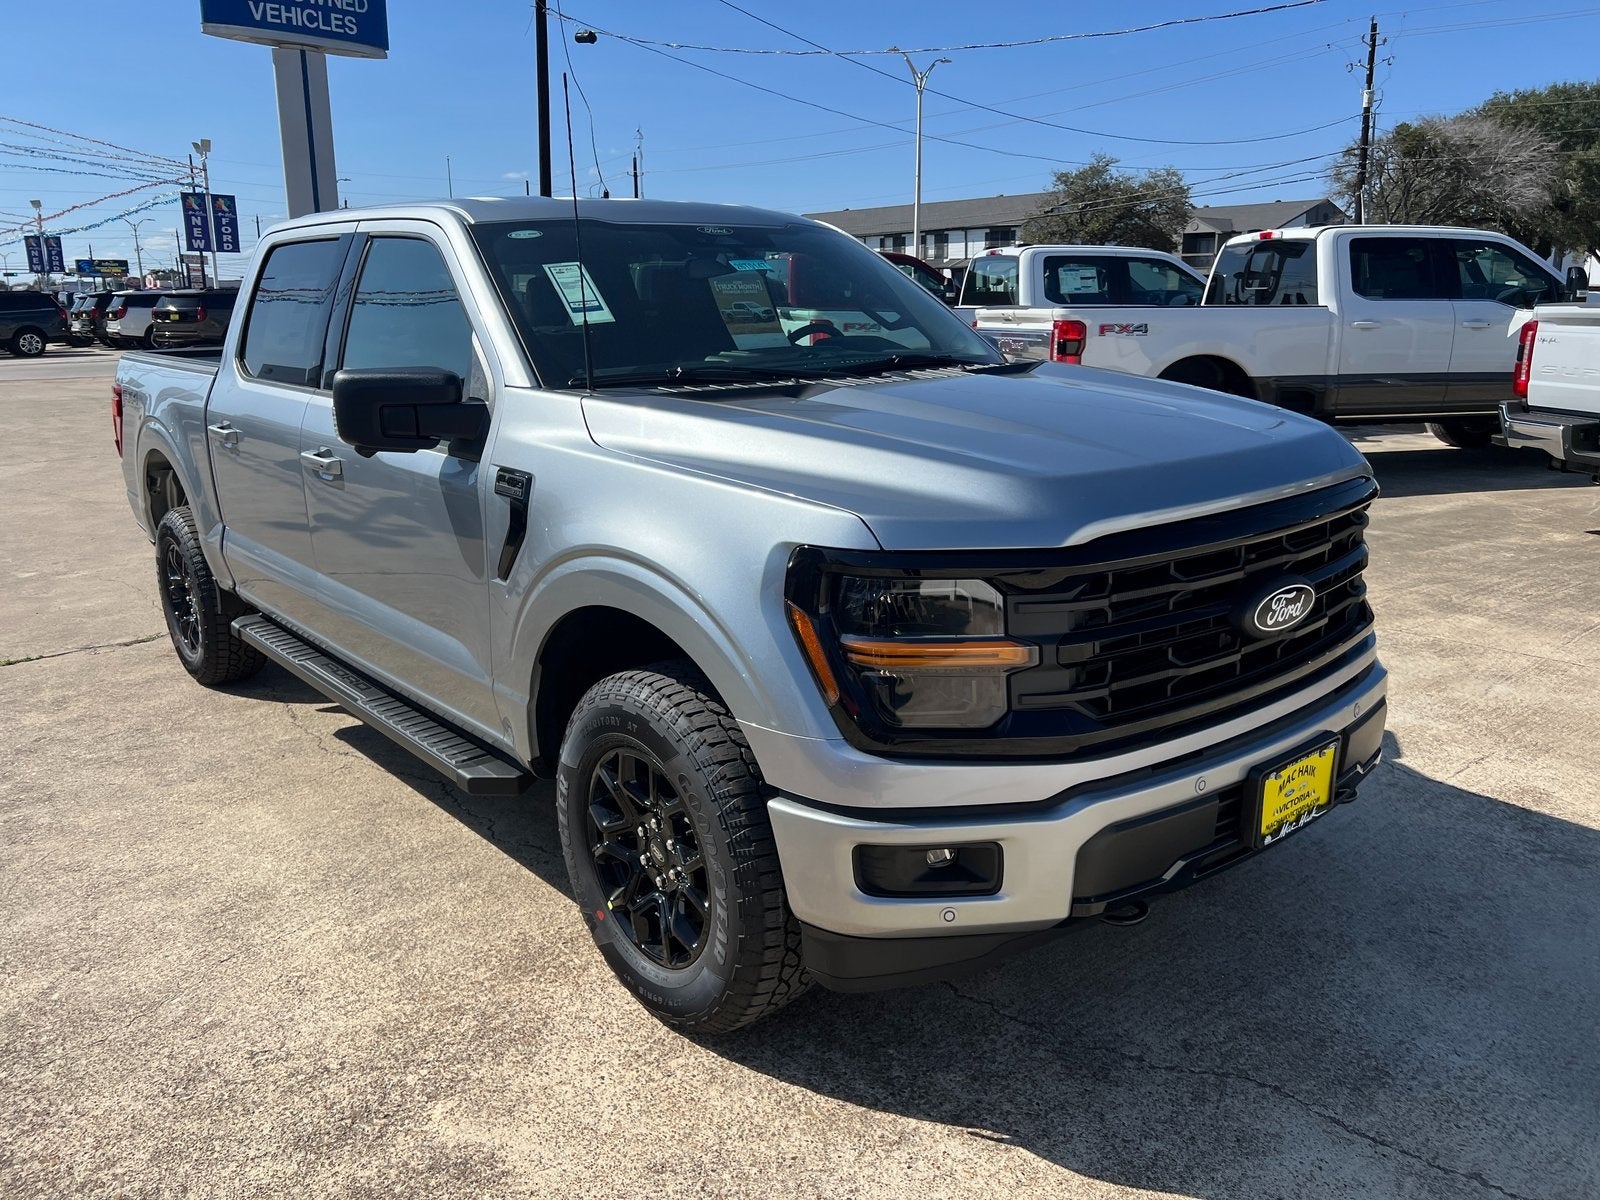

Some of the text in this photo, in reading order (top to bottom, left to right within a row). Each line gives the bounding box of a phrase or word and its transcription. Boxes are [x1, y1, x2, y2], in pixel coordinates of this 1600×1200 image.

[248, 1, 358, 35] VEHICLES
[191, 216, 205, 249] NEW
[221, 217, 233, 251] FORD
[31, 250, 41, 271] NEW
[51, 250, 61, 272] FORD
[1098, 322, 1149, 336] FX4
[1266, 591, 1305, 625] Ford
[1277, 768, 1297, 797] MAC
[1297, 764, 1316, 778] HAIK
[1279, 790, 1311, 813] VICTORIA
